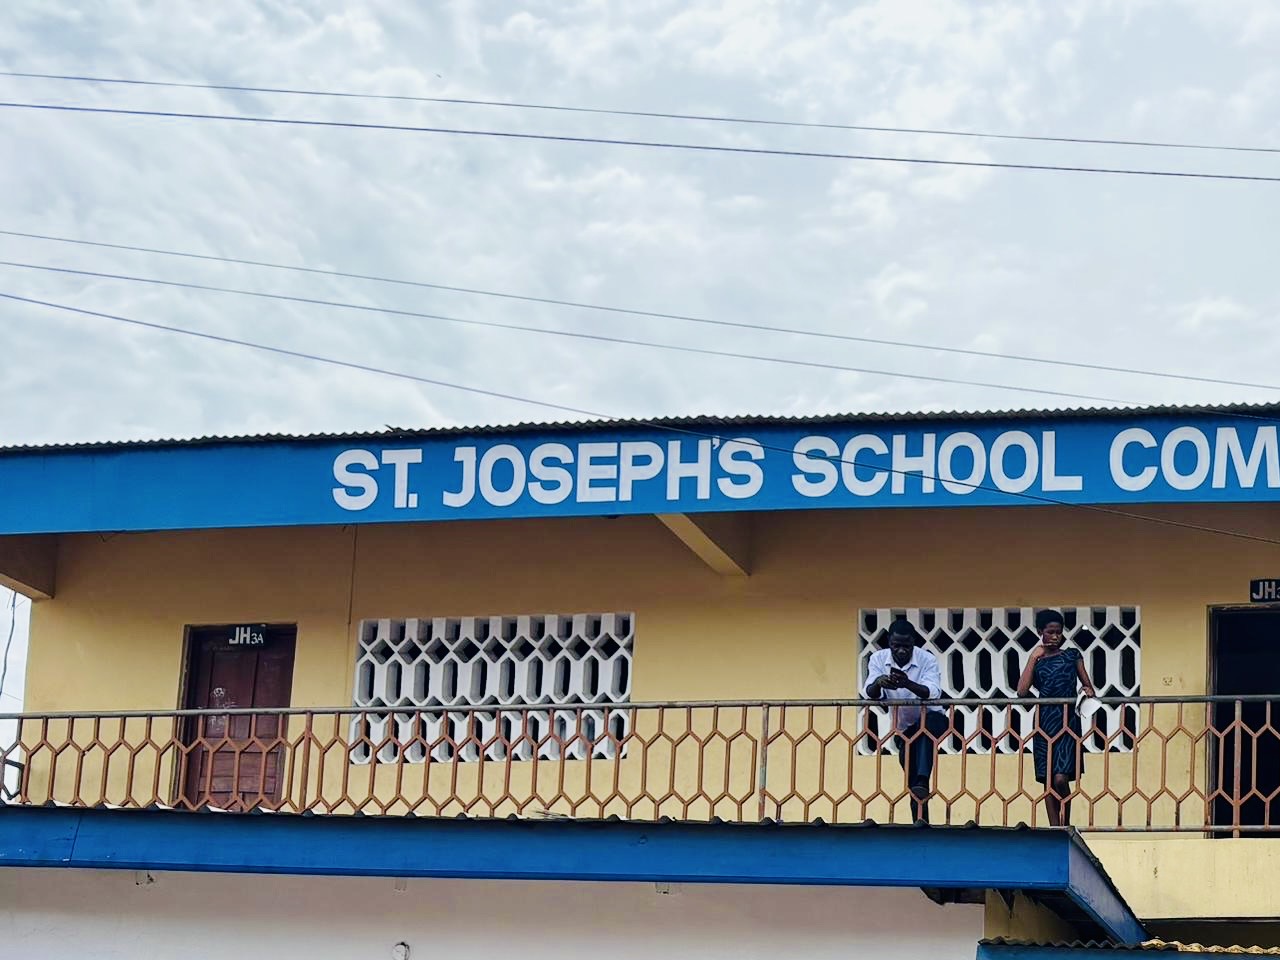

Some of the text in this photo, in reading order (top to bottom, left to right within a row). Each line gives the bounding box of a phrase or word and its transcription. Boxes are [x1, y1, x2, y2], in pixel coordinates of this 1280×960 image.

[332, 448, 422, 511] ST.
[443, 436, 765, 507] JOSEPH'S
[791, 430, 1083, 497] SCHOOL
